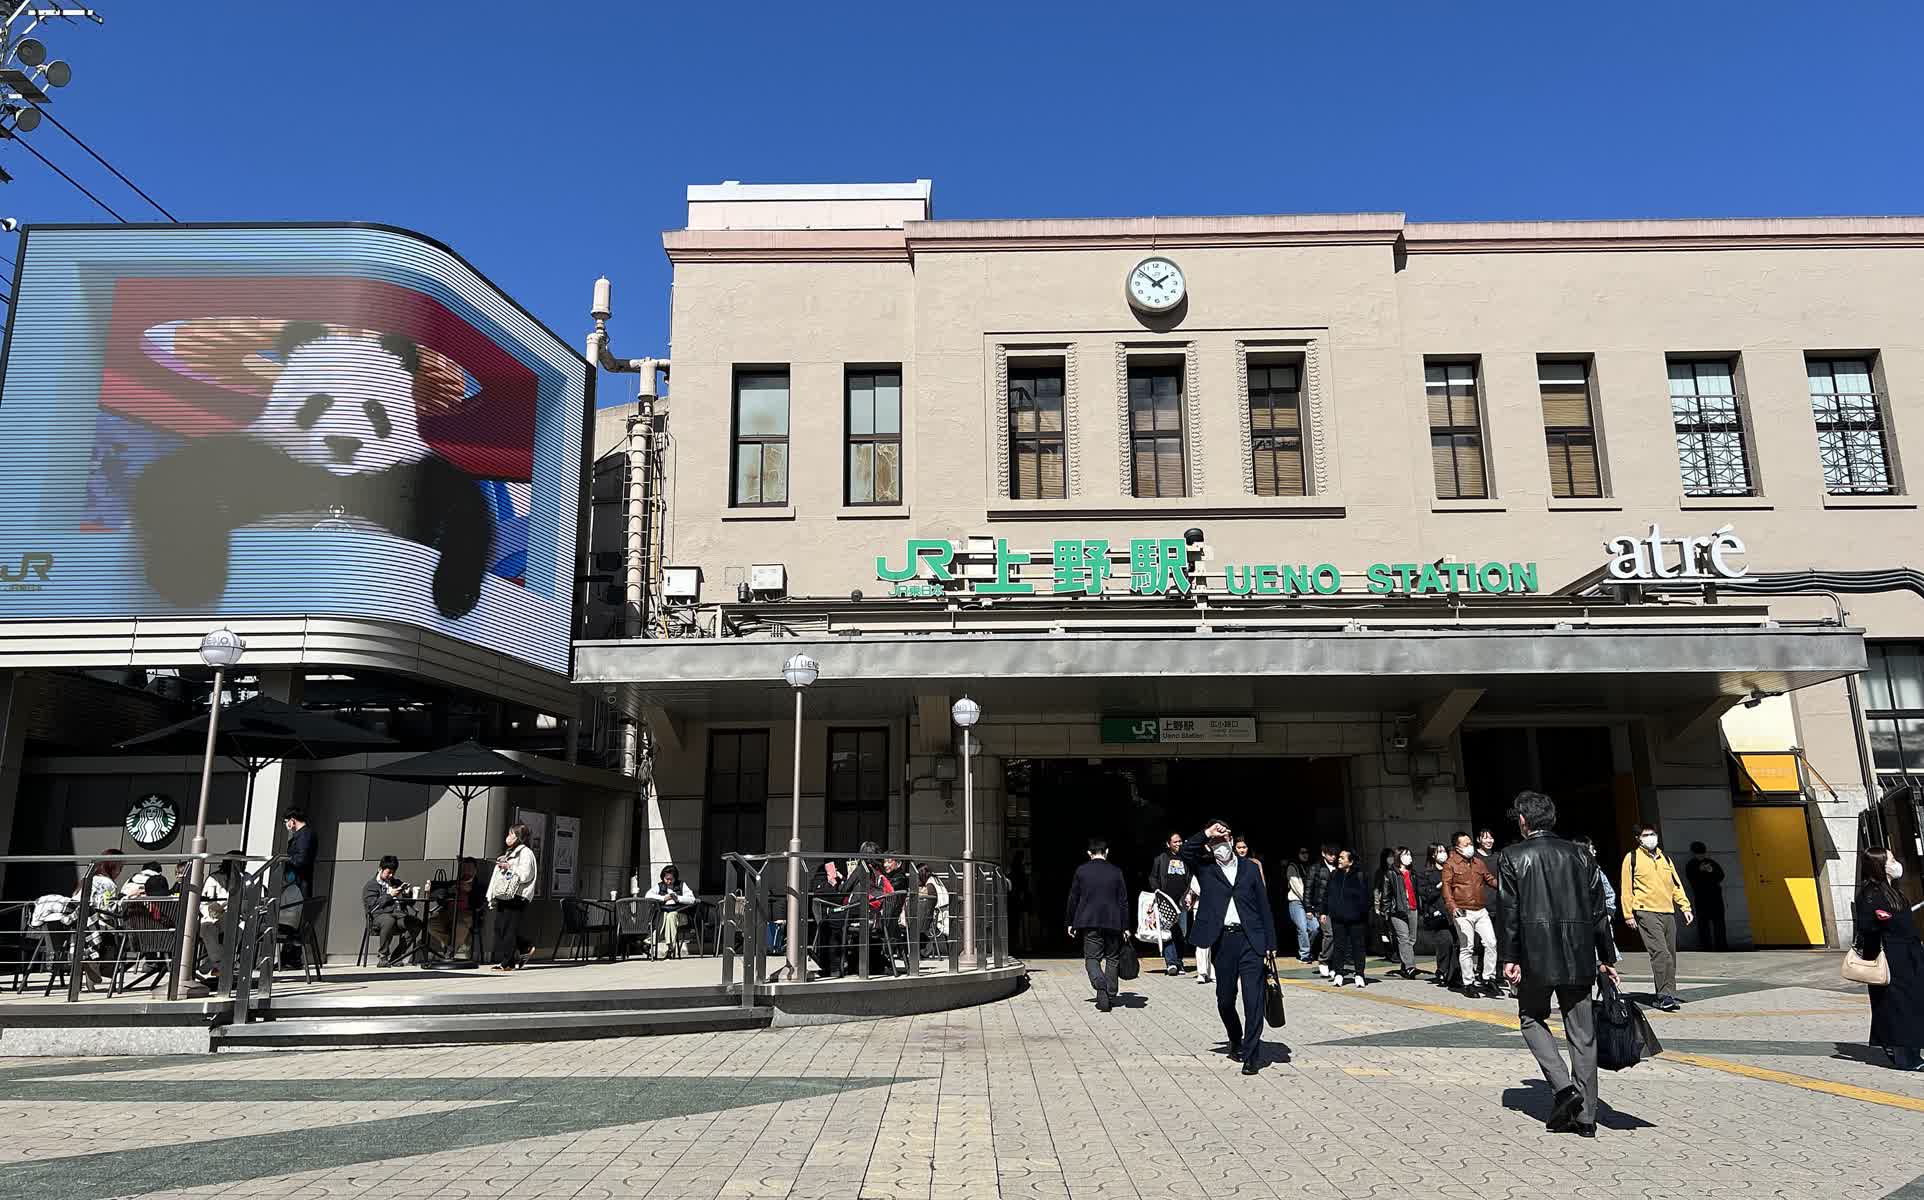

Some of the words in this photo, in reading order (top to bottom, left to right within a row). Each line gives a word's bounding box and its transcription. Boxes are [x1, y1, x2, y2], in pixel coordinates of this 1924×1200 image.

[1604, 522, 1749, 578] atré
[0, 552, 54, 582] JR
[876, 539, 954, 581] JR
[975, 537, 1191, 595] 上野駅
[1225, 563, 1341, 594] UENO
[1367, 562, 1538, 593] STATION
[888, 584, 945, 597] JR東日本
[1132, 720, 1158, 735] JR
[1163, 719, 1194, 731] 上野駅
